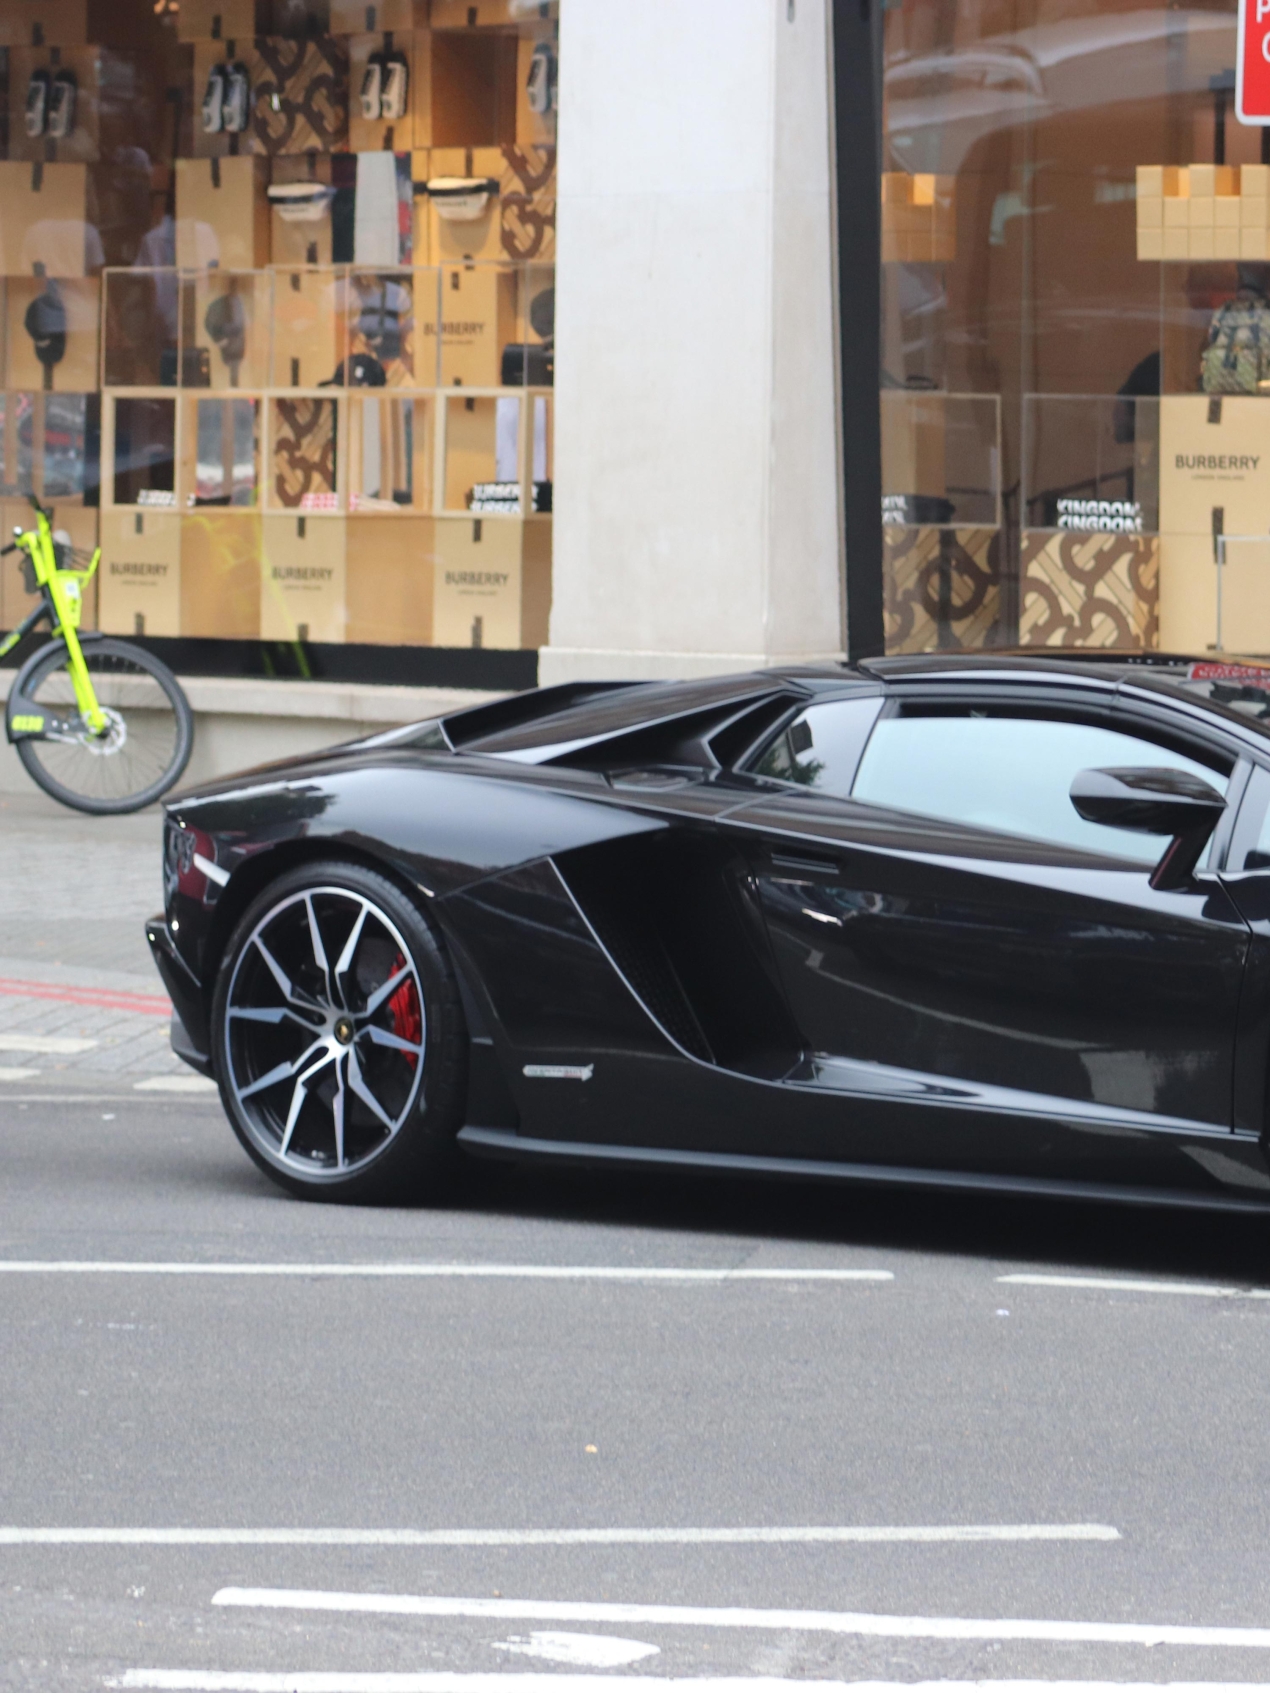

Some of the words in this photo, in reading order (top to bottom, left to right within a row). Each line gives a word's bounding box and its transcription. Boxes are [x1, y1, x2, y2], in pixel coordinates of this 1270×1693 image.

[1175, 454, 1260, 470] BURBERRY
[110, 562, 168, 576] BURBERRY
[271, 566, 333, 581] BURBERRY
[445, 571, 508, 586] BURBERRY
